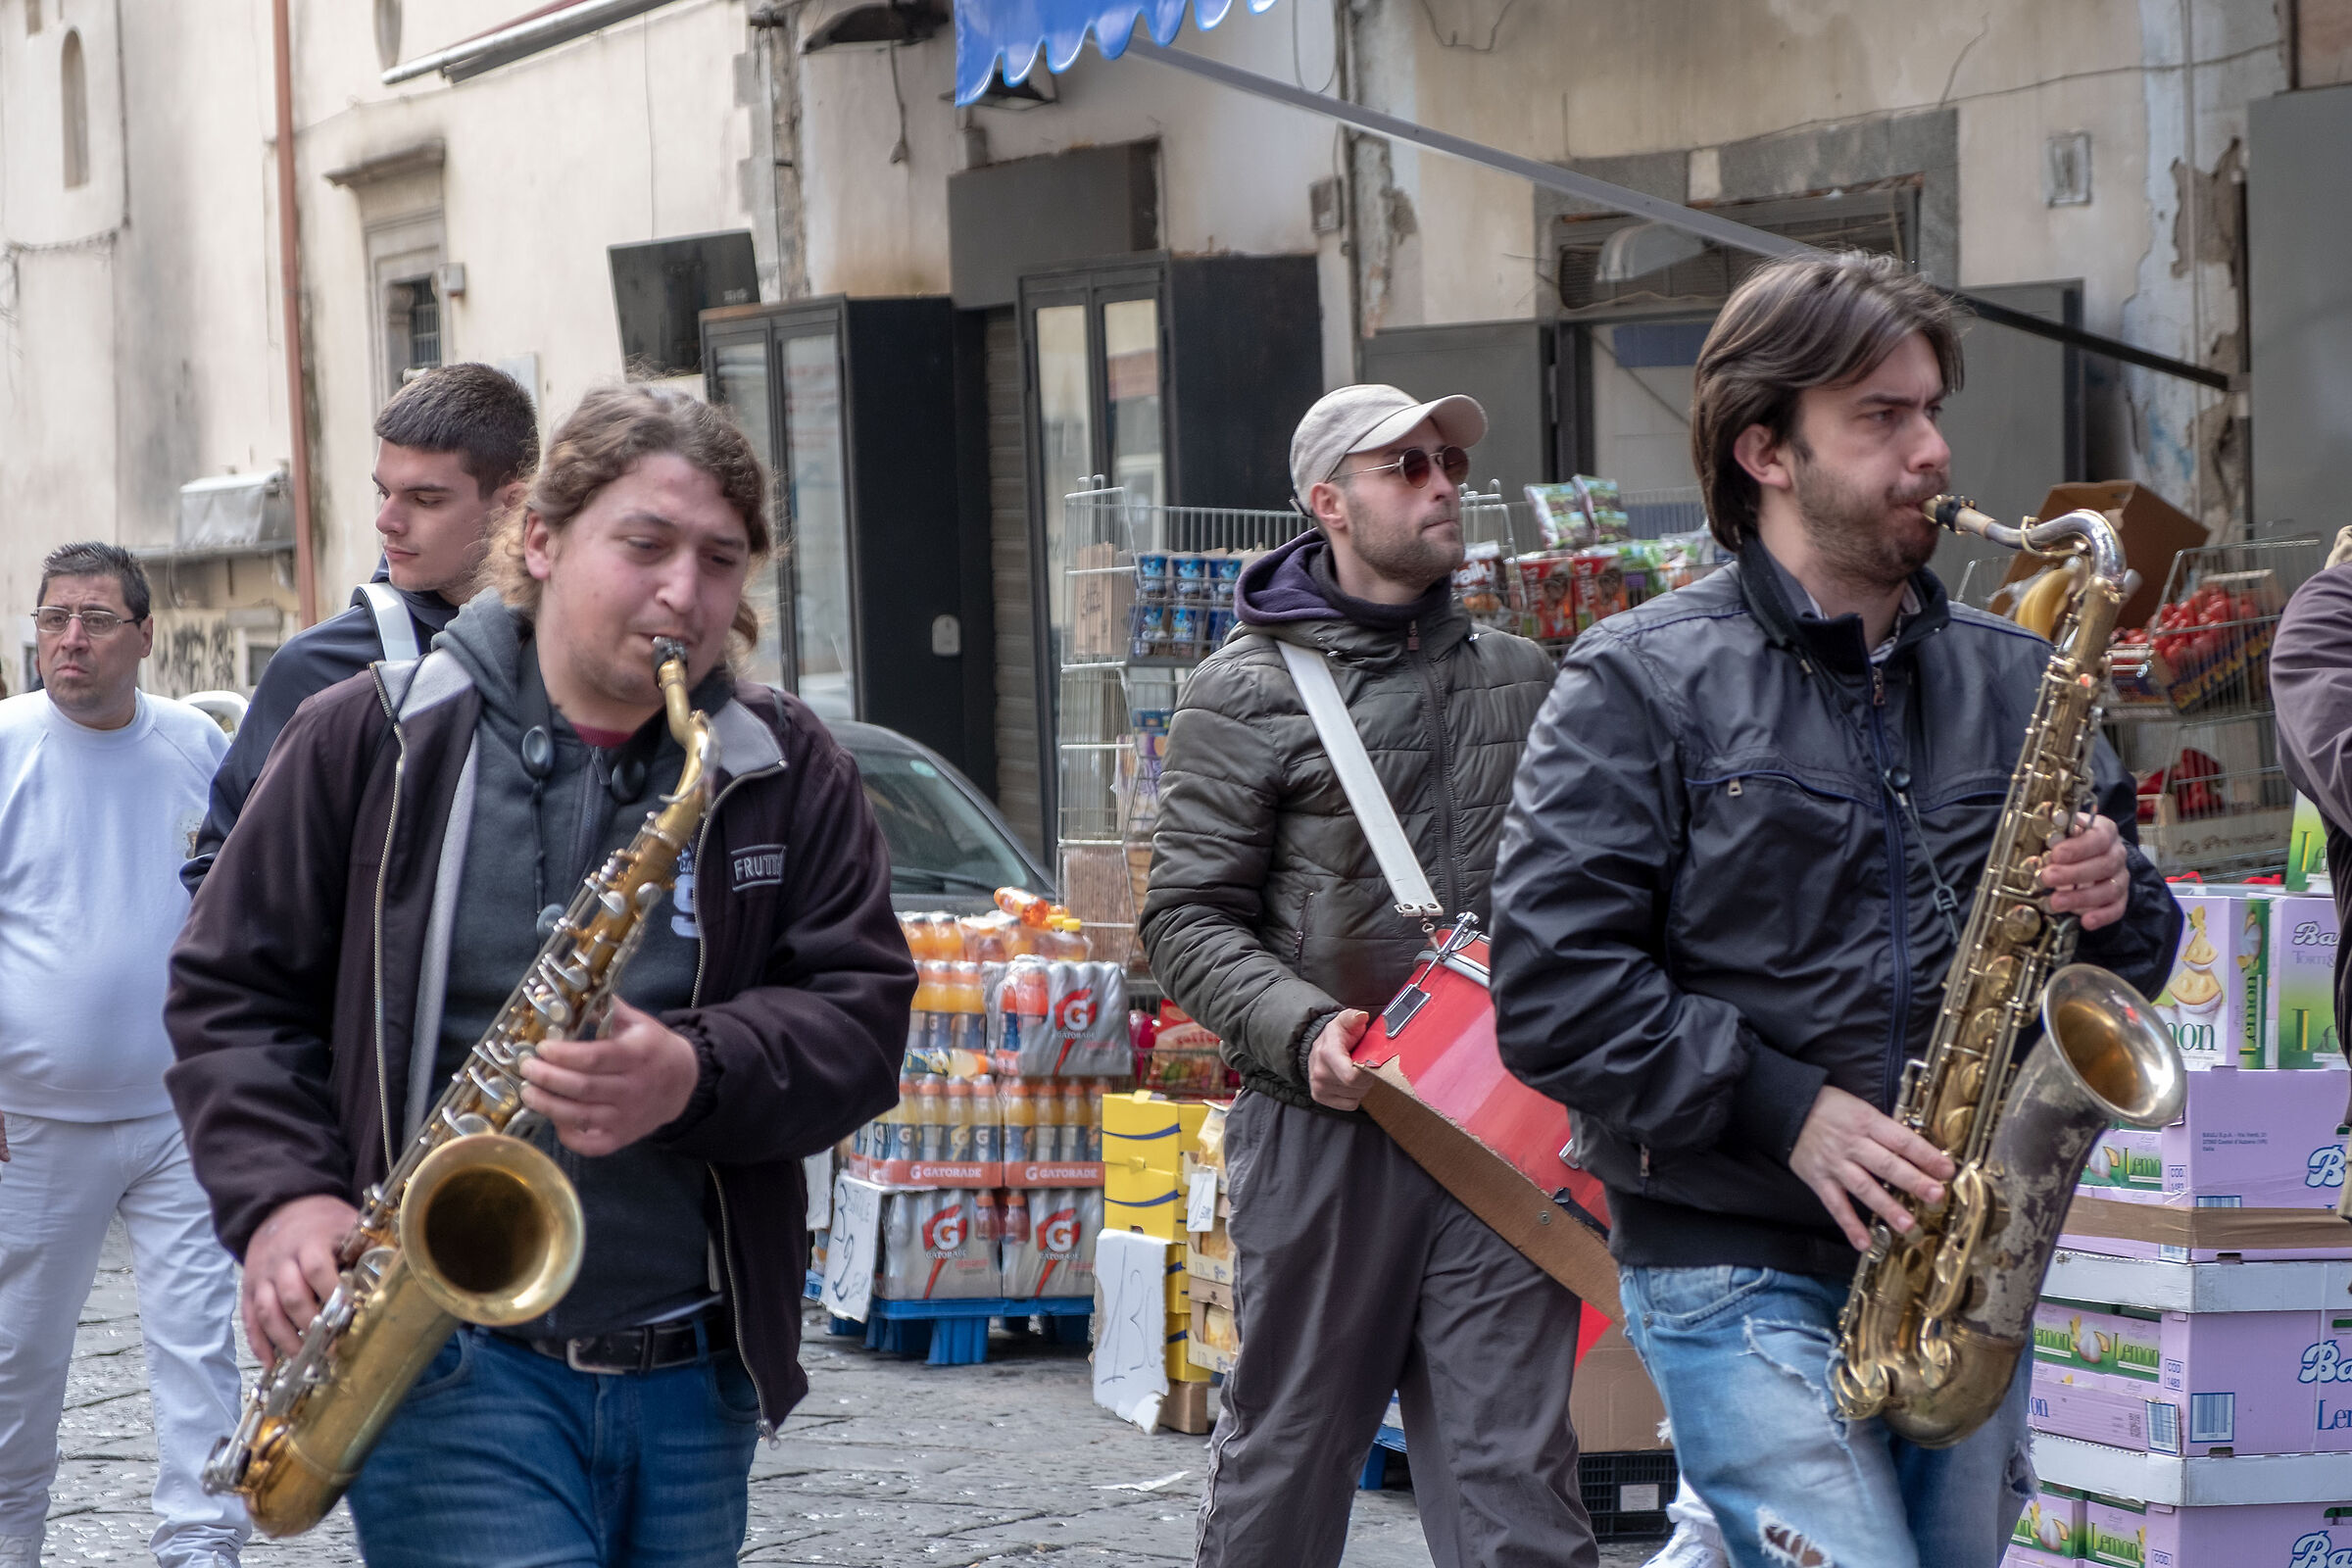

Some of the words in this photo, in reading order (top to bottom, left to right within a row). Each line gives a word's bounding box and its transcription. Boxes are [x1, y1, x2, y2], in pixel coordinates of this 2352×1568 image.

[2292, 921, 2340, 946] Ba
[922, 1167, 982, 1179] GATORADE
[1040, 1168, 1098, 1179] GATORADE
[2034, 1327, 2071, 1350] emon
[2114, 1333, 2159, 1367] Lemon
[2028, 1396, 2049, 1418] on
[2091, 1521, 2138, 1560] Lemon
